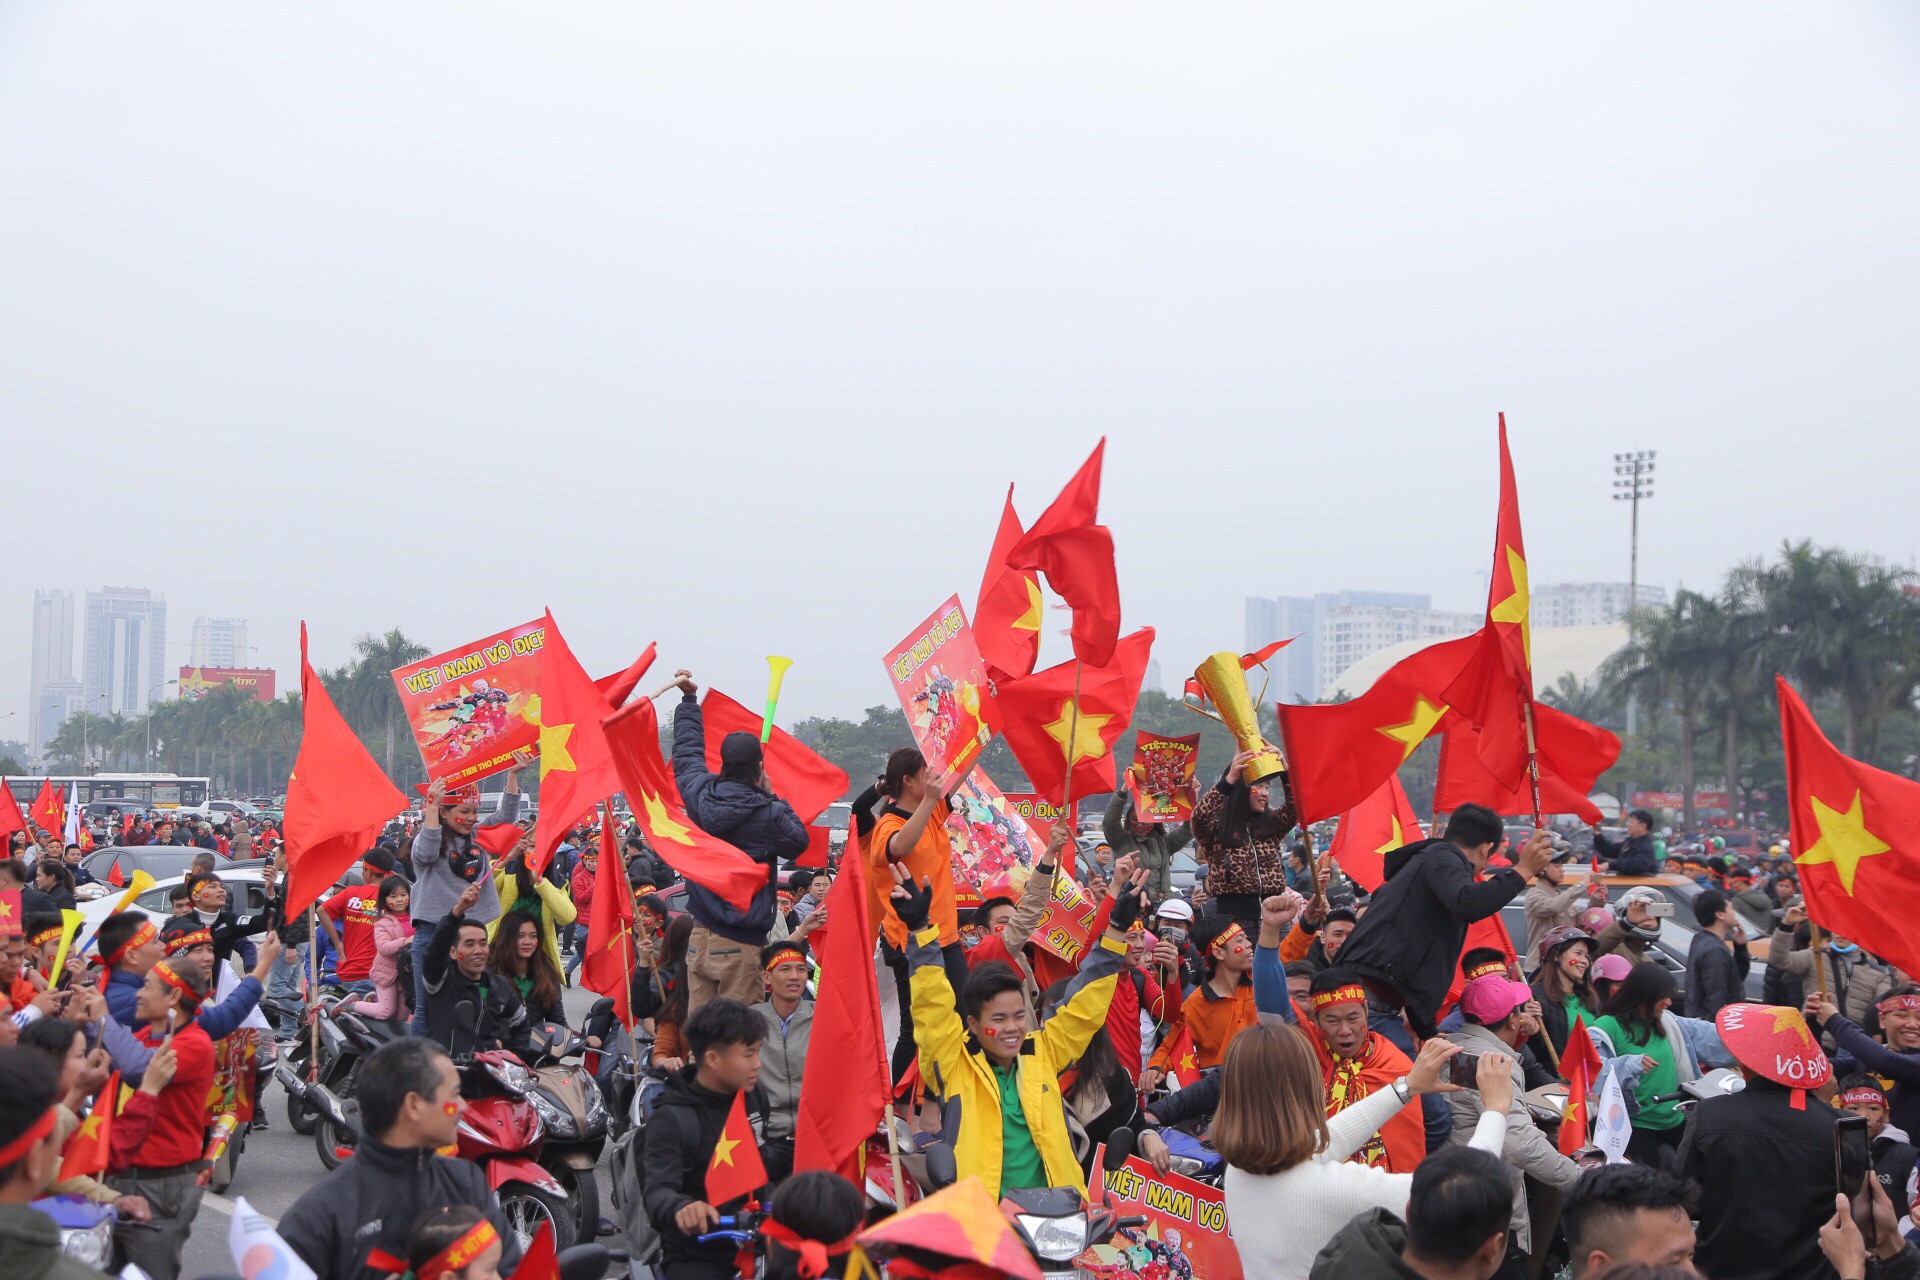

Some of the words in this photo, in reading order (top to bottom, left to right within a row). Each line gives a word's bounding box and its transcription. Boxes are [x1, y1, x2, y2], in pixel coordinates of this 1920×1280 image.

[891, 653, 914, 683] VIỆT
[910, 634, 934, 668] NAM
[929, 621, 946, 648] VÔ
[942, 607, 964, 637] ĐỊCH
[404, 668, 440, 694] VIỆT
[443, 653, 485, 681] NAM
[485, 640, 511, 665] VÔ
[1140, 740, 1168, 752] VIỆT
[1169, 742, 1194, 753] NAM
[461, 765, 478, 777] TIEN
[479, 760, 493, 771] THO
[1149, 806, 1160, 814] VÔ
[1316, 992, 1332, 1005] NAM
[1344, 986, 1356, 999] VÔ
[1776, 1054, 1804, 1080] VÔ
[1105, 1168, 1144, 1200] VIỆT
[1145, 1181, 1193, 1221] NAM
[1198, 1200, 1226, 1231] VÔ
